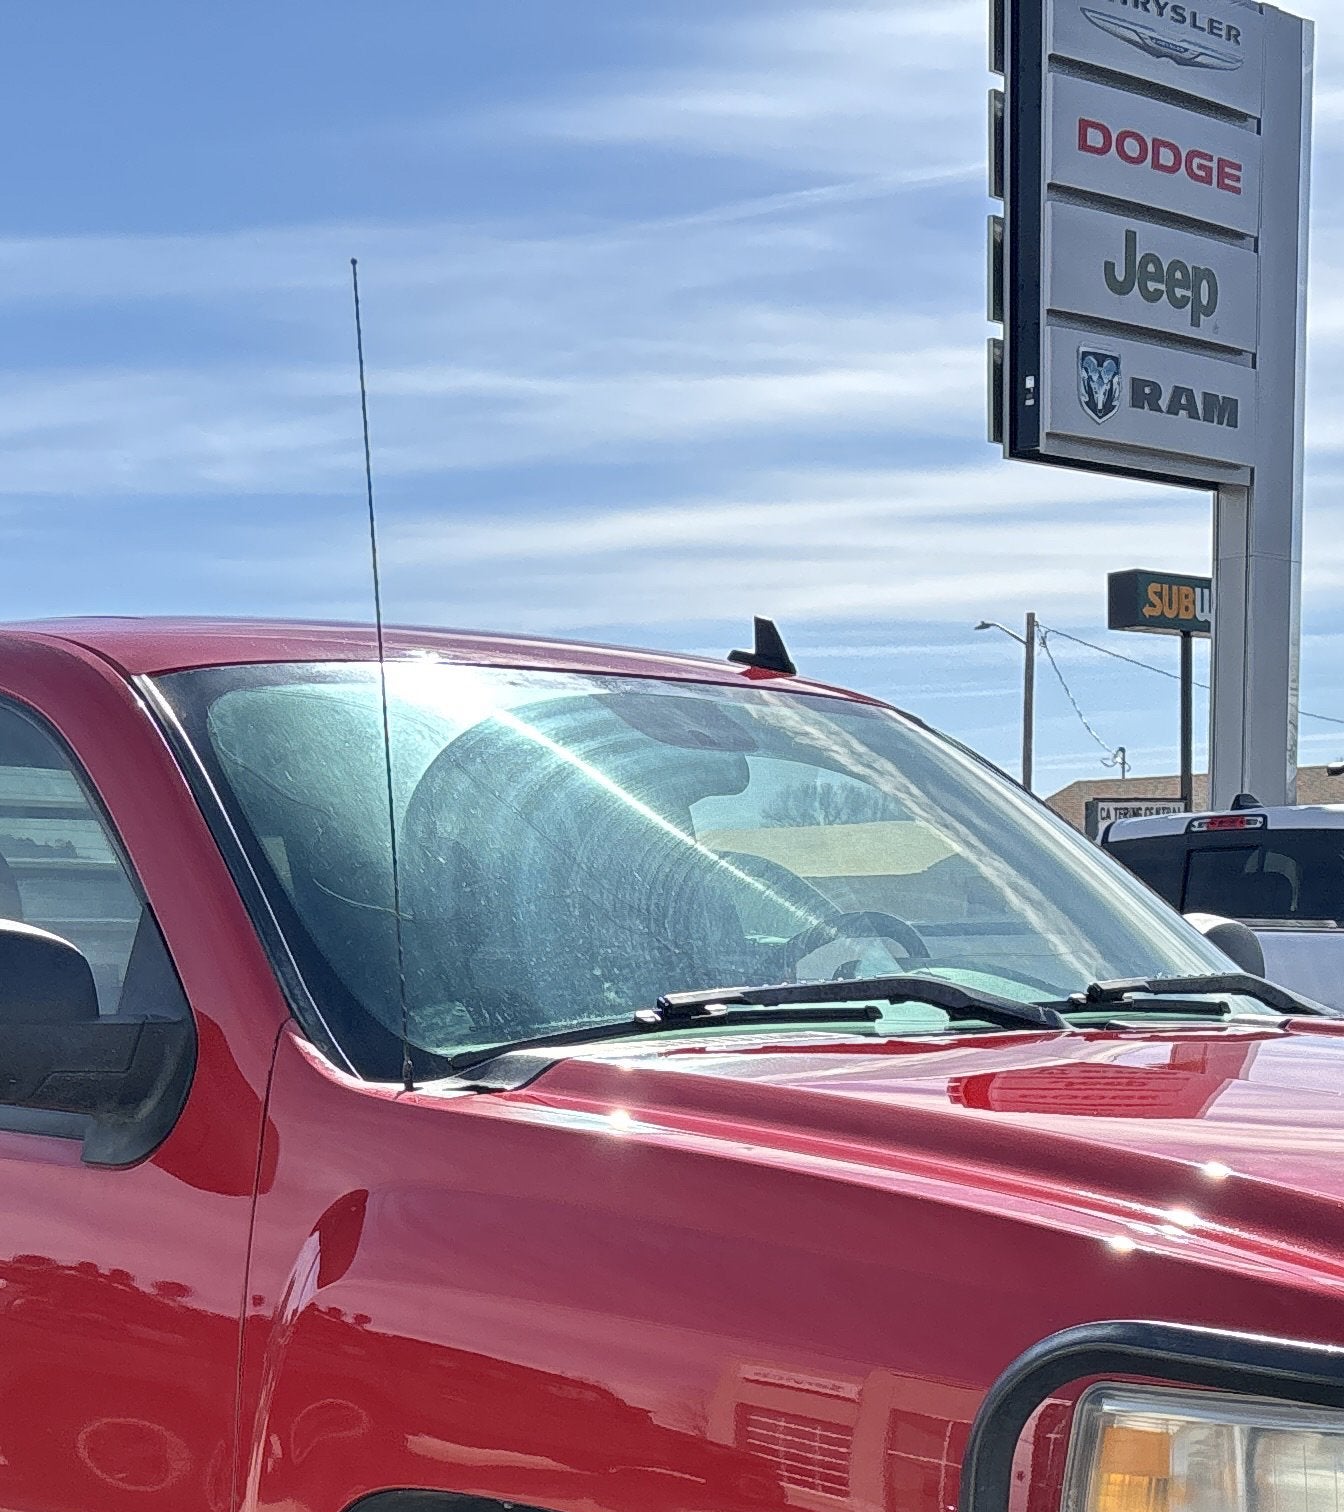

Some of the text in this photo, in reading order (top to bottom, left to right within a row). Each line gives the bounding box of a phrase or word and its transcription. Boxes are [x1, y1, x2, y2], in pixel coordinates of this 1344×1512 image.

[1108, 0, 1241, 46] RYSLER
[1078, 117, 1242, 195] DODGE
[1104, 229, 1218, 327] Jeep
[1129, 376, 1238, 428] RAM
[1142, 582, 1212, 622] SUBW
